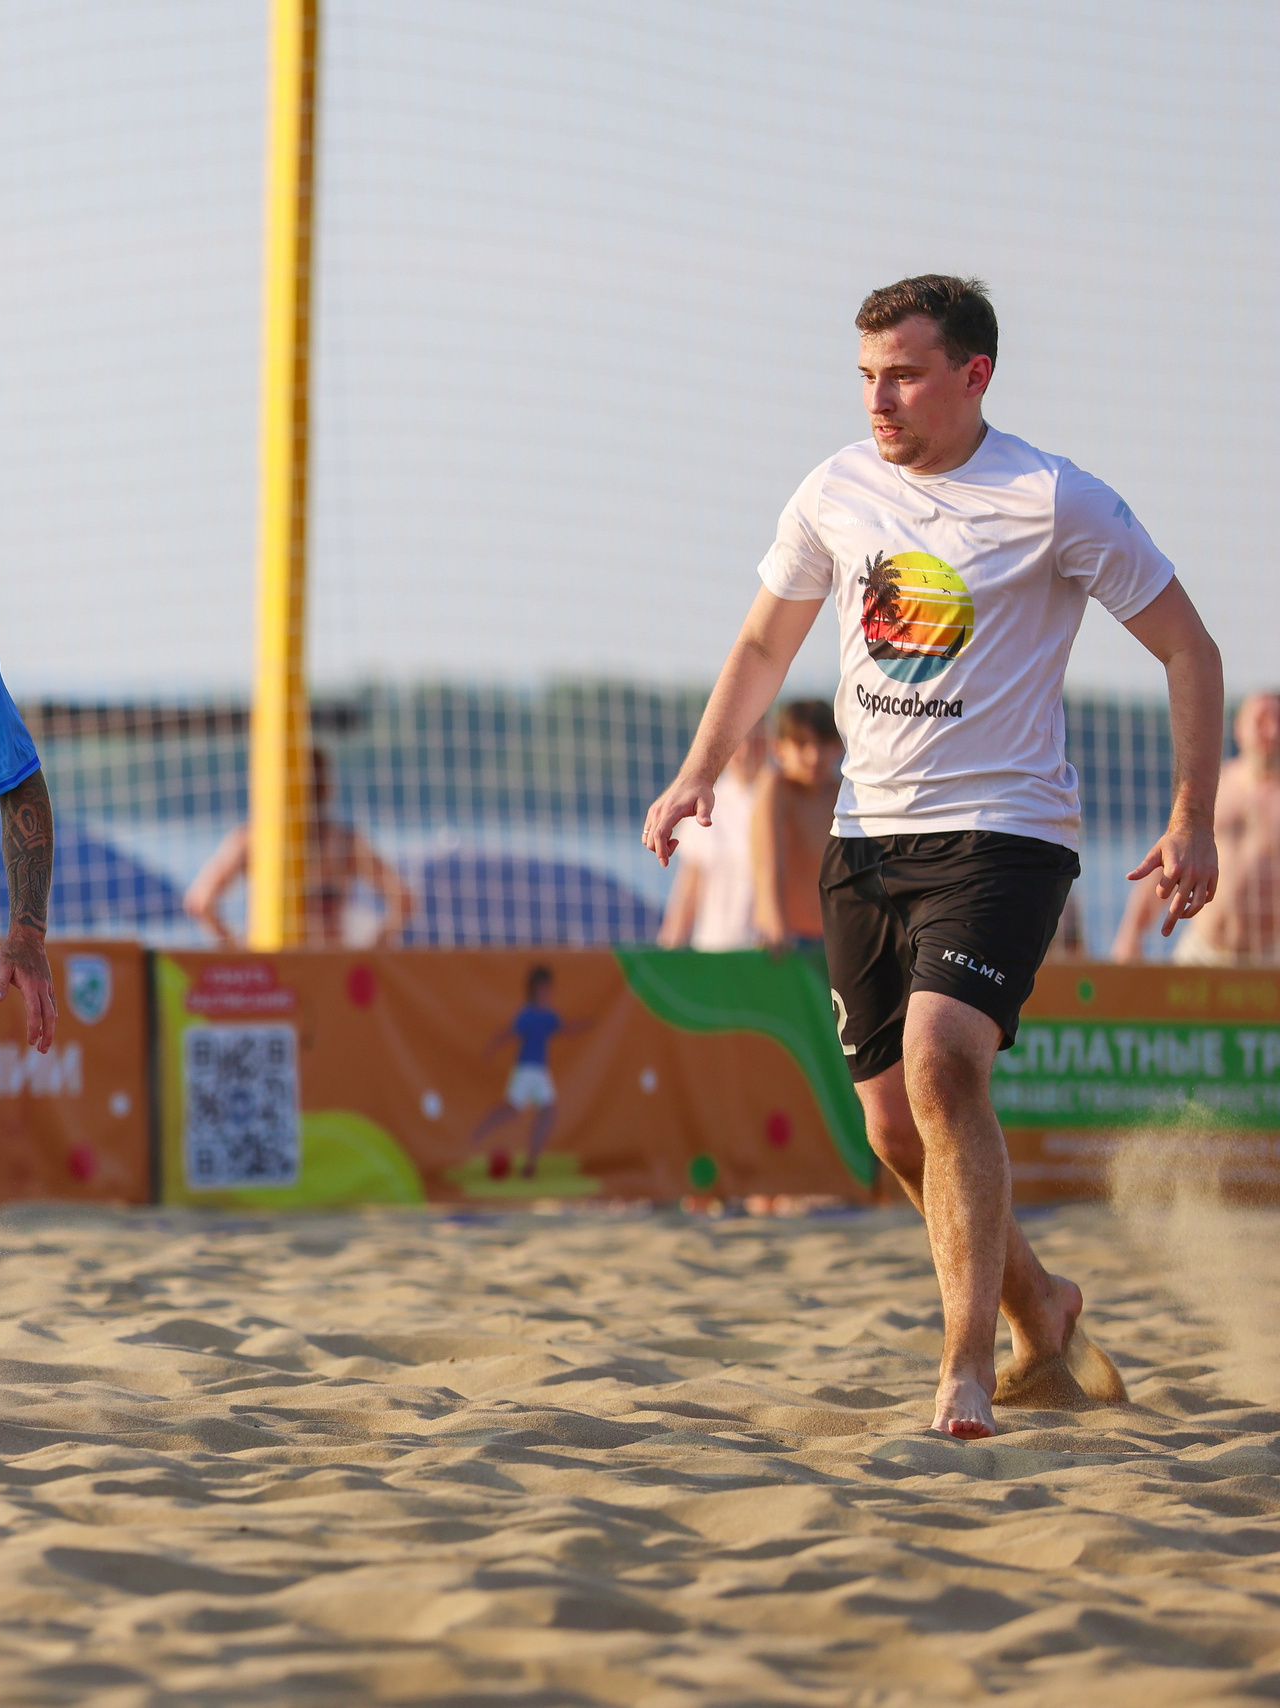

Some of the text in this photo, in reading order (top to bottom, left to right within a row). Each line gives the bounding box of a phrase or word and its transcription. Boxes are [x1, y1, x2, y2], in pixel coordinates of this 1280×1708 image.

[856, 683, 964, 718] Copacabana
[941, 949, 1006, 986] KELME
[994, 1029, 1223, 1076] СПЛАТНЫЕ
